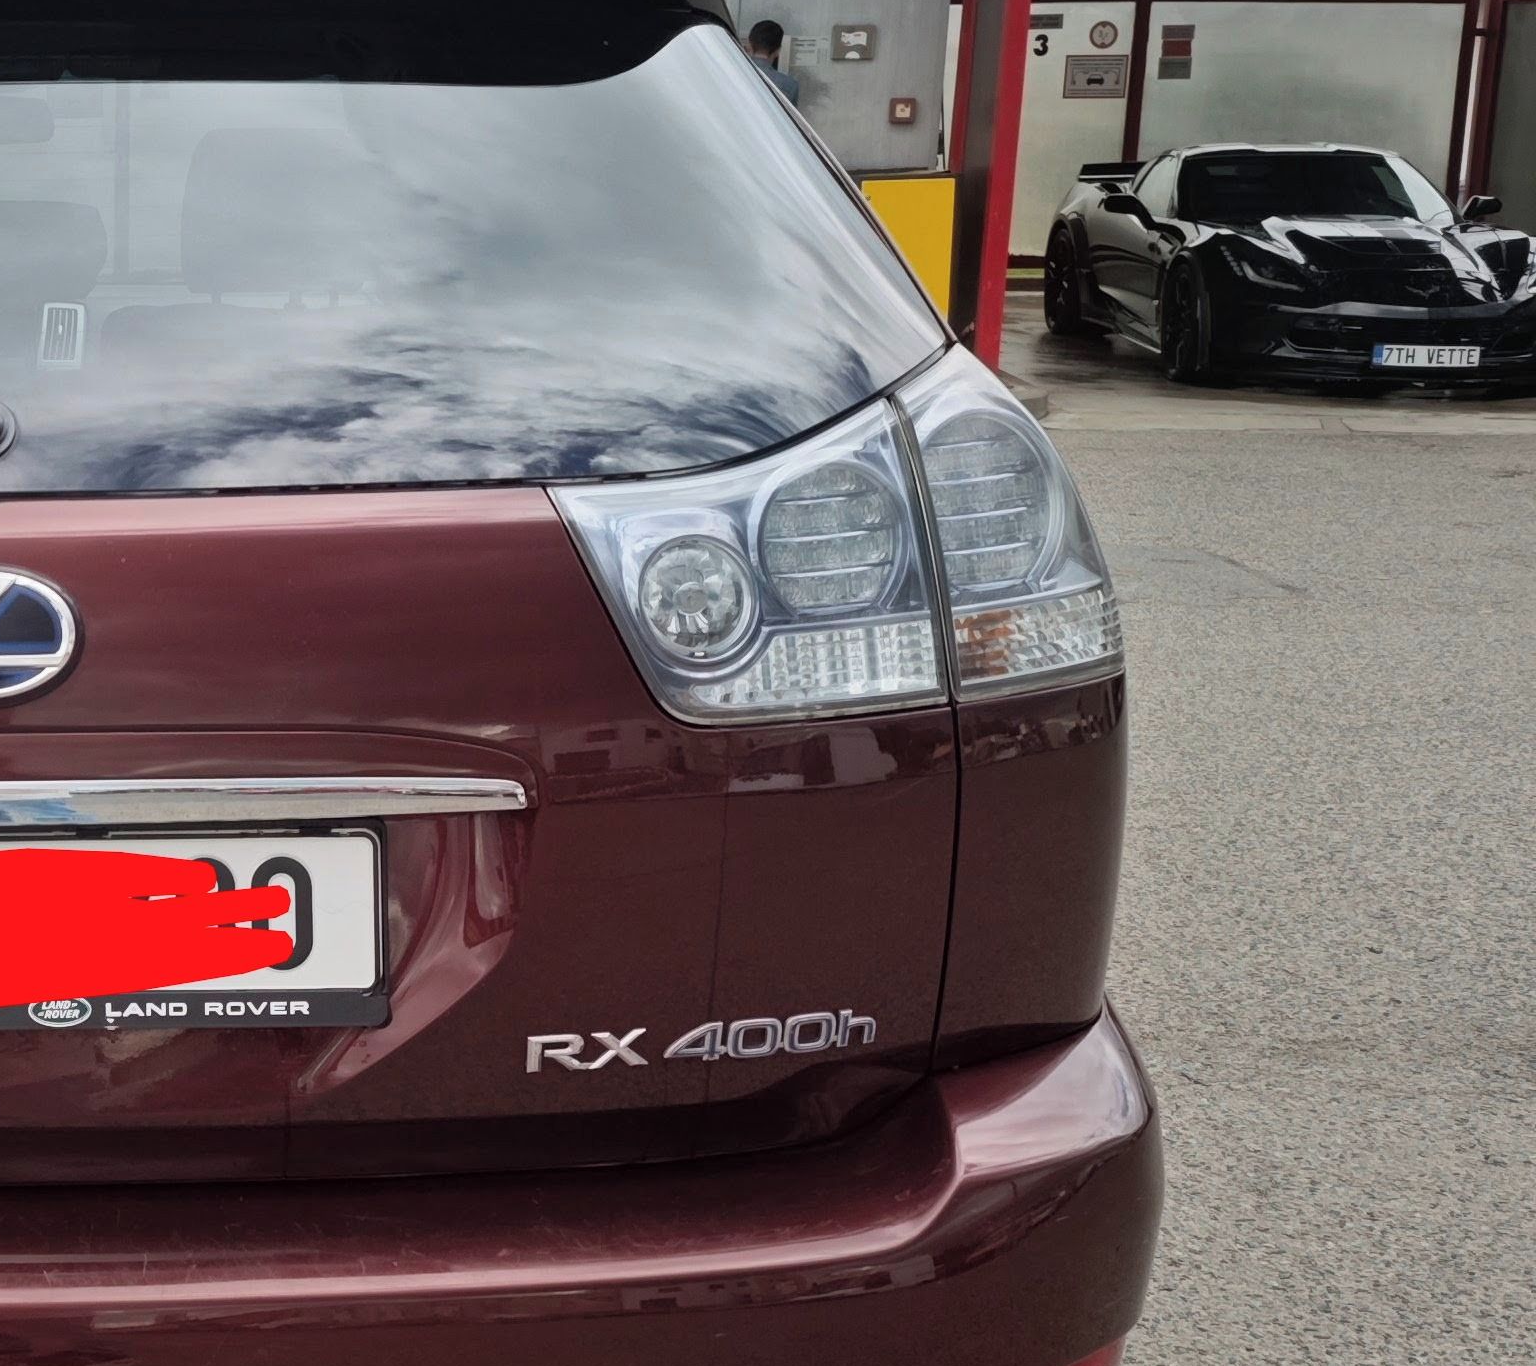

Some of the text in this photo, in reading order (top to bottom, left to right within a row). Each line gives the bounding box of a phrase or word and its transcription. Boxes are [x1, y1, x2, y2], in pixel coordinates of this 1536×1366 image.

[1033, 34, 1049, 56] 3
[1384, 347, 1477, 365] 7TH VETTE
[41, 1000, 72, 1010] LAND
[44, 1009, 81, 1019] ROVER
[105, 1000, 311, 1018] LAND ROVER
[526, 1009, 877, 1074] RX 400h
